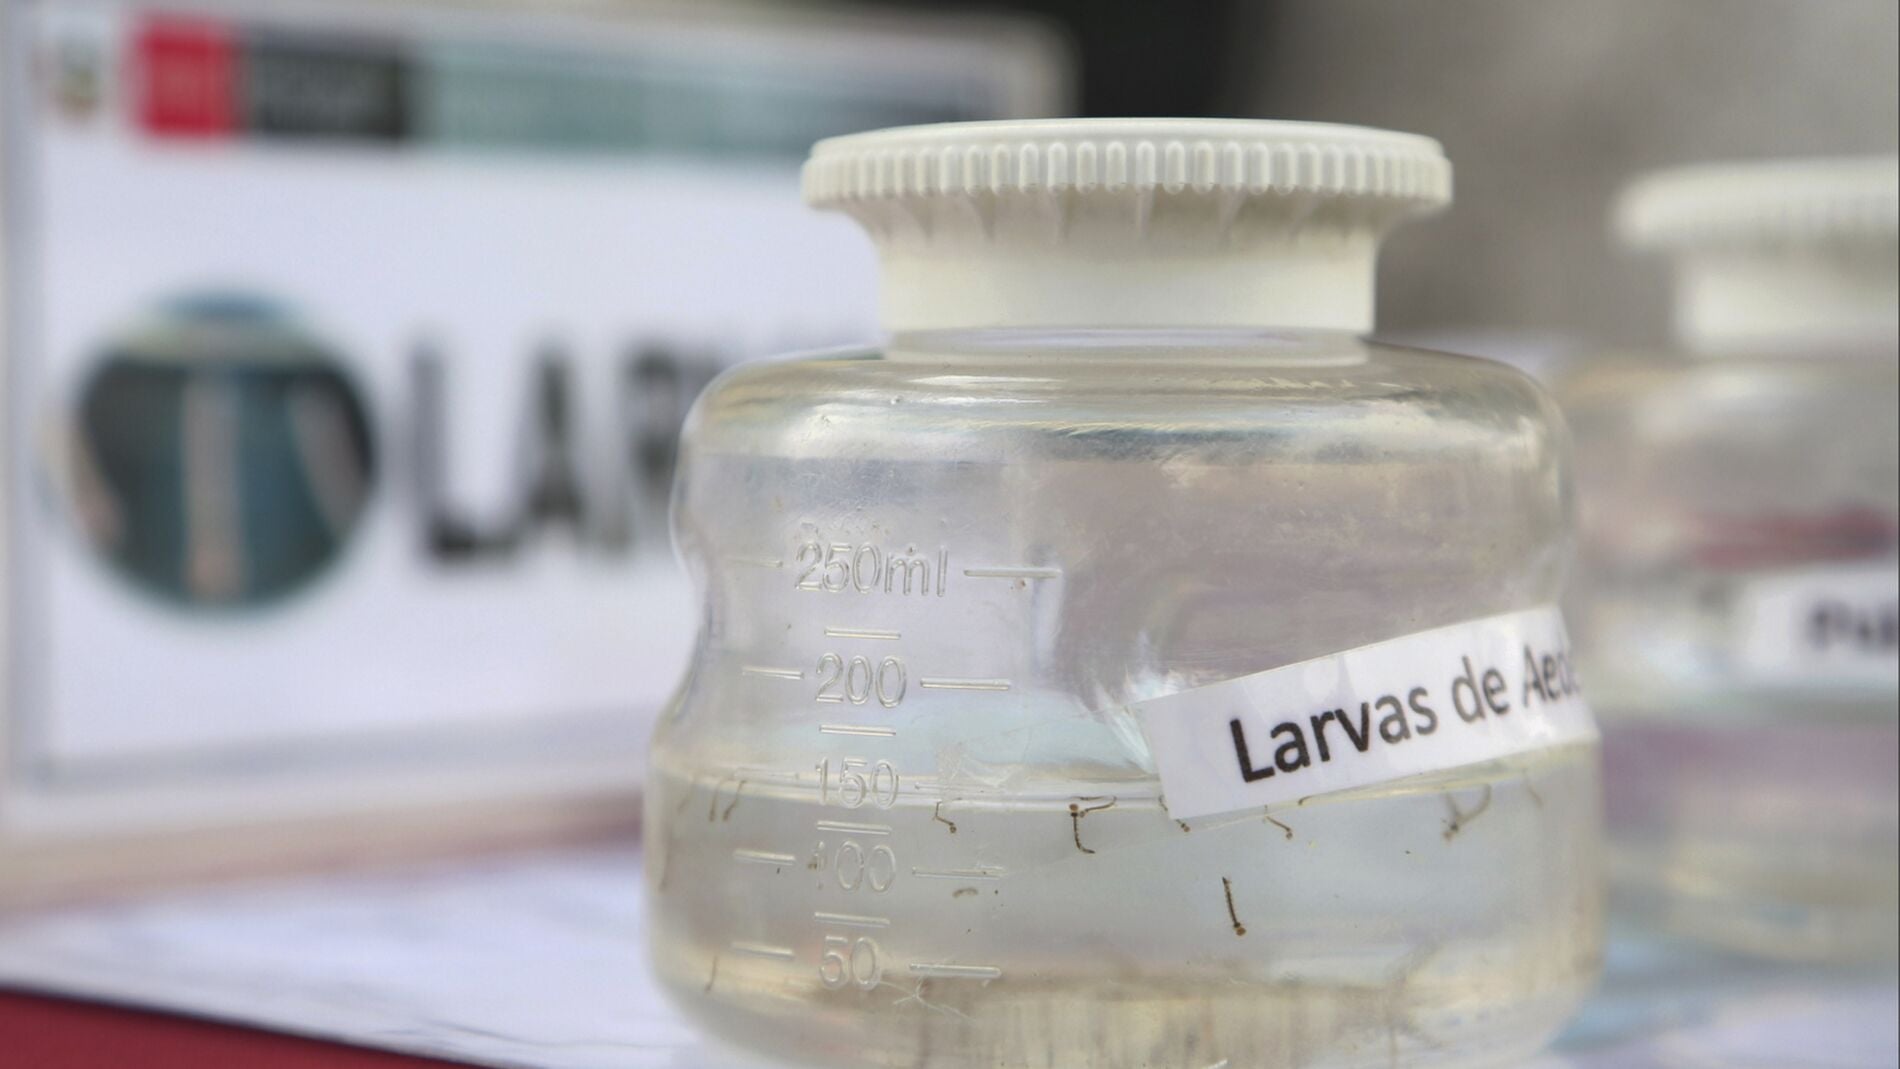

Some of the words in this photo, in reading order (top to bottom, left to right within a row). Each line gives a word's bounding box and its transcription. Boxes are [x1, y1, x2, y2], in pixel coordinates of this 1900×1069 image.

[795, 542, 949, 598] 250ml
[815, 651, 908, 708] 200
[1229, 685, 1439, 784] Larvas
[1450, 655, 1510, 724] de
[814, 756, 899, 809] 150
[812, 840, 897, 894] 100
[818, 935, 883, 991] 50
